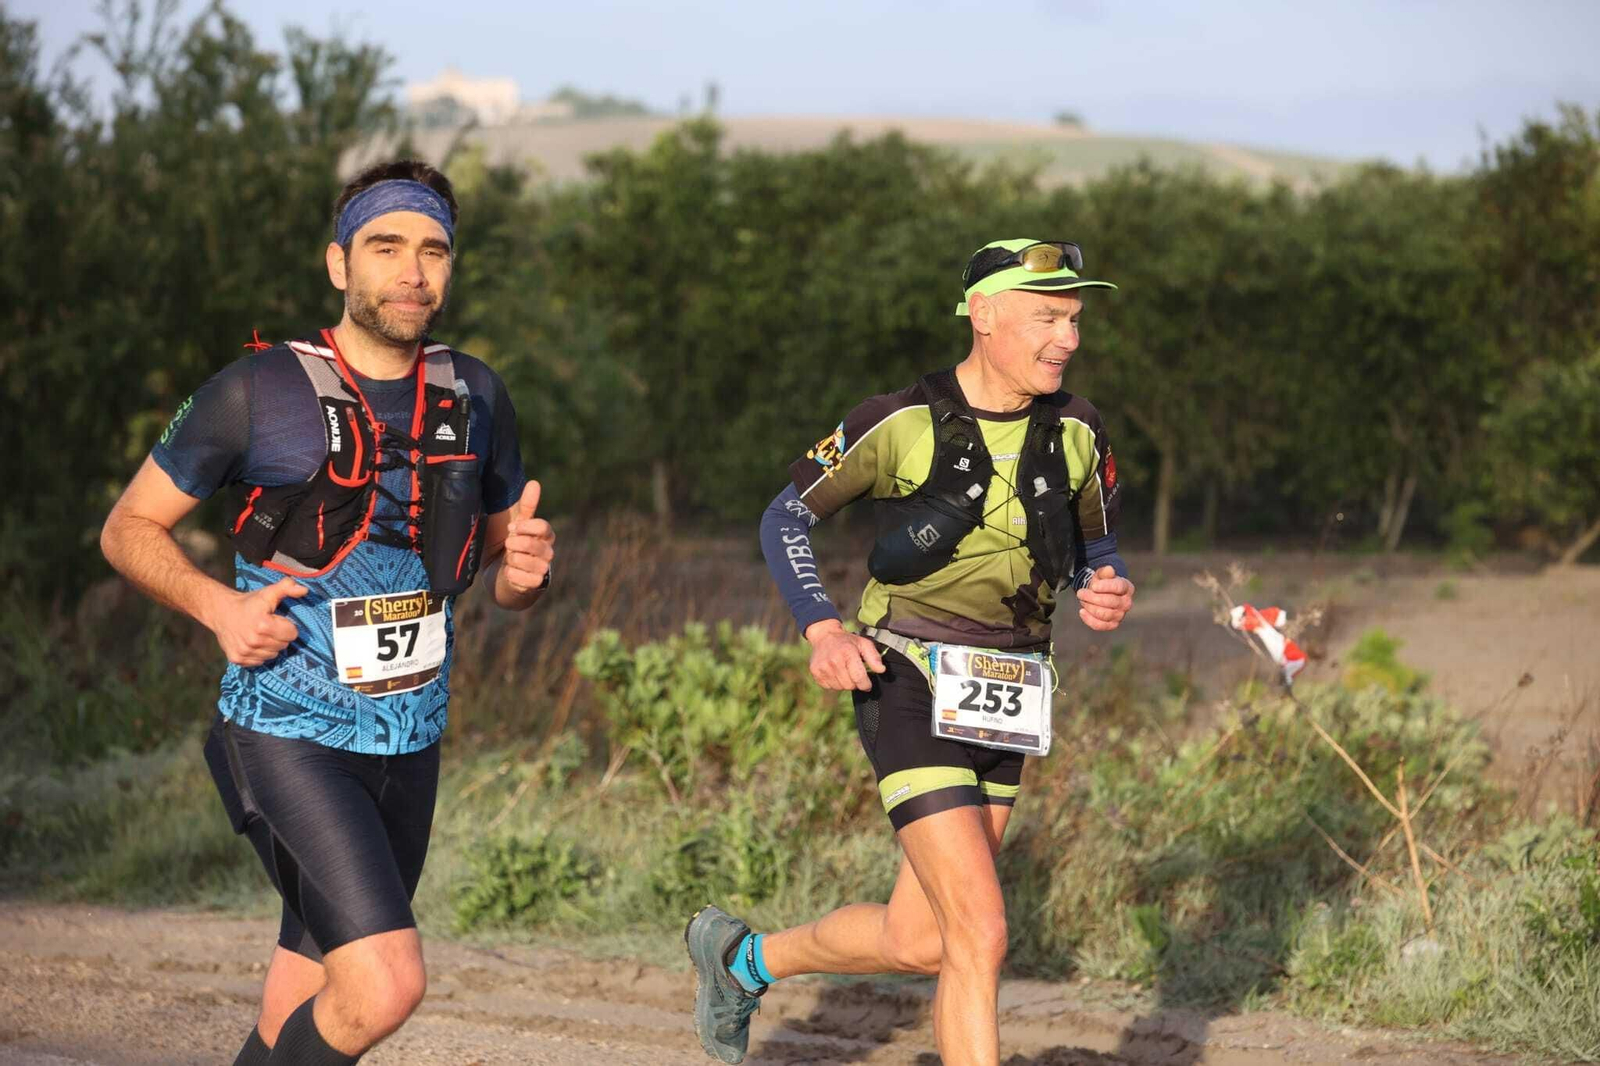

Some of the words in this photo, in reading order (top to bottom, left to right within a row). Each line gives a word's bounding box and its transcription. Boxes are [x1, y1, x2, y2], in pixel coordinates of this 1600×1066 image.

[371, 596, 424, 615] Sherry
[377, 622, 420, 662] 57
[382, 659, 419, 672] ALEJANDRO
[974, 655, 1020, 679] Sherry
[958, 680, 1023, 717] 253
